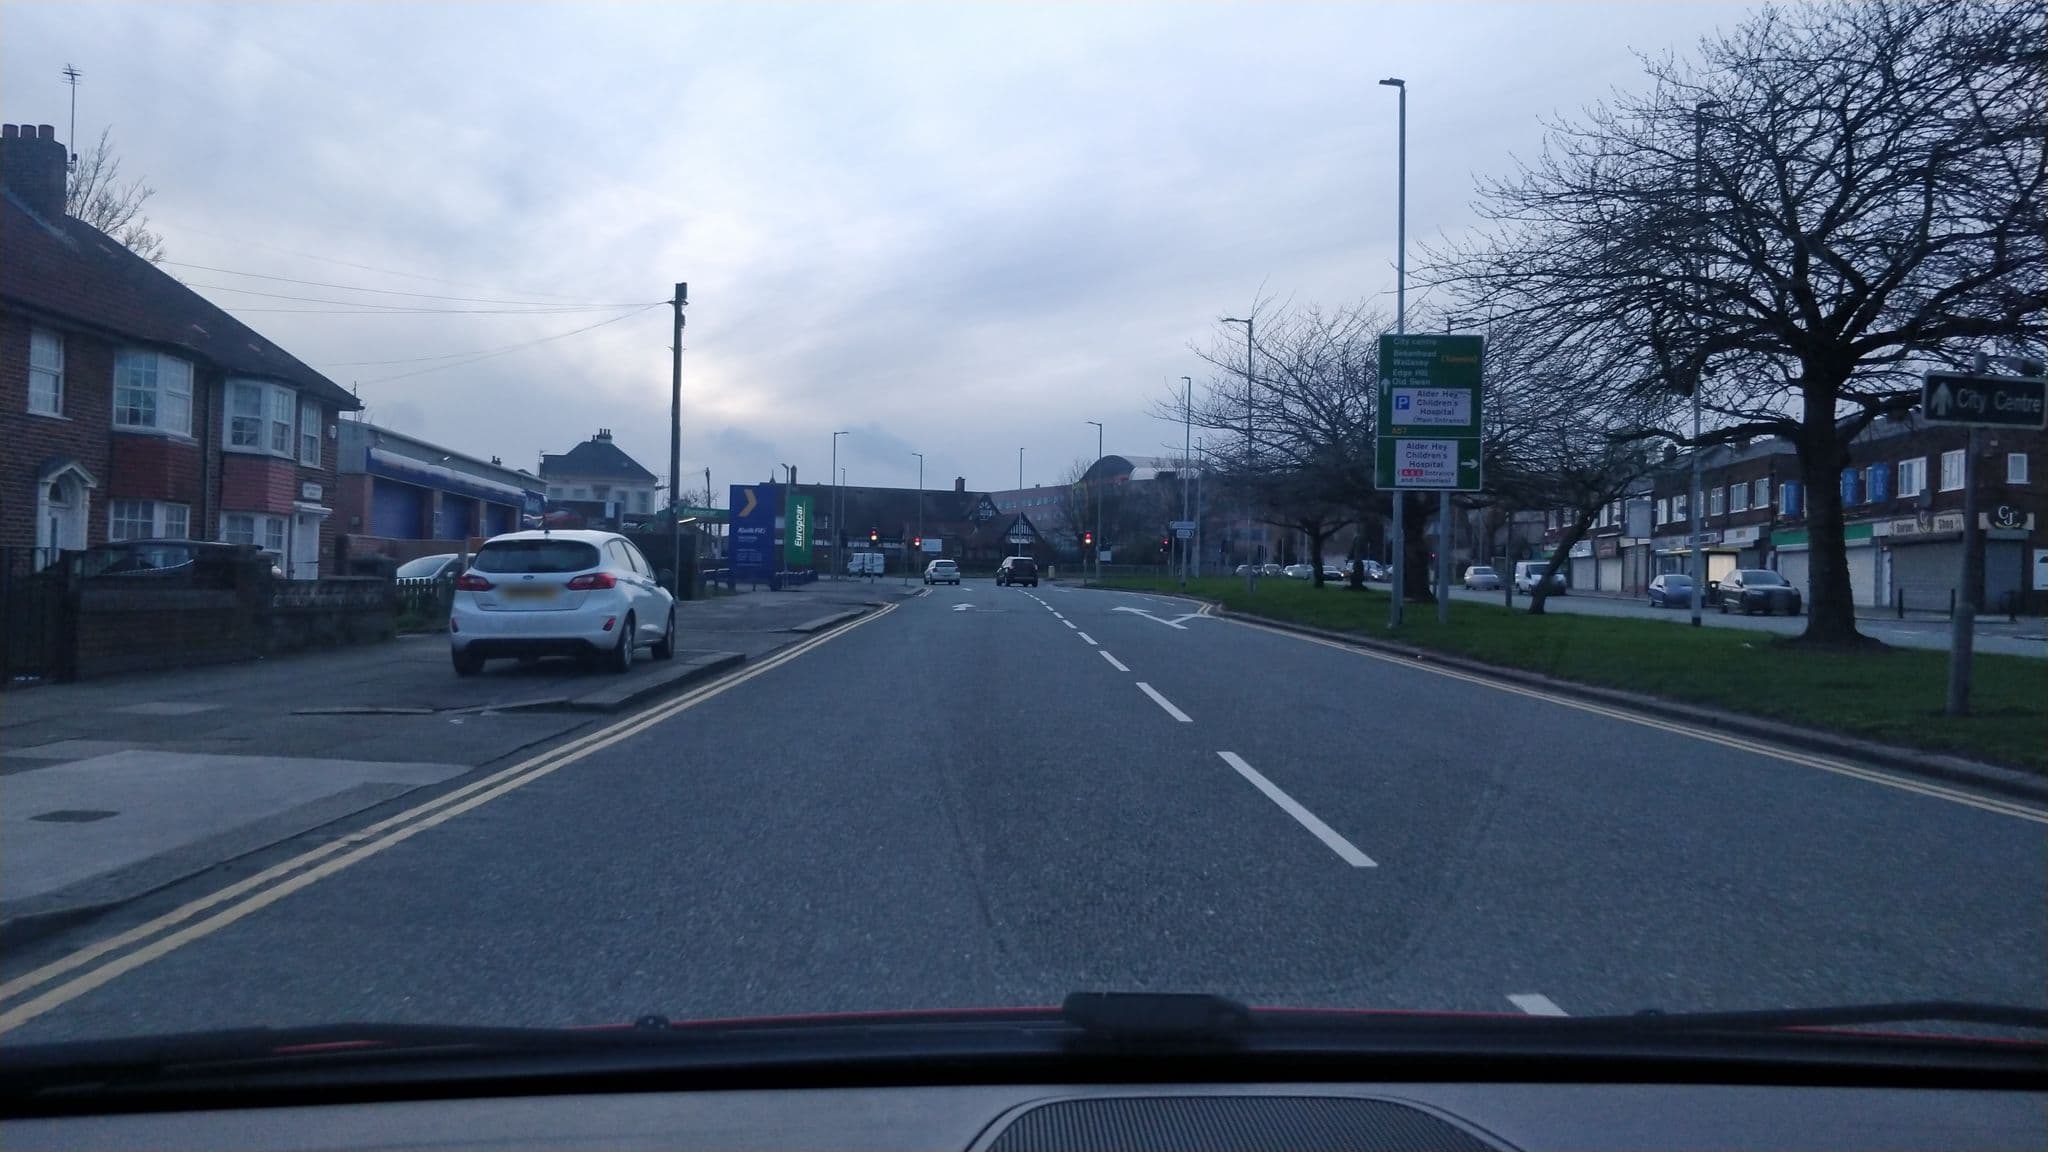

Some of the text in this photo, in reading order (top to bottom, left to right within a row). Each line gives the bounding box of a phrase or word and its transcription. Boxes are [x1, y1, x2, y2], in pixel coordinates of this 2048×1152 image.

[1392, 377, 1407, 385] Old
[1416, 390, 1458, 399] Alder Hey
[1416, 399, 1458, 407] Children's
[1957, 387, 2042, 414] City Centre
[1420, 408, 1455, 417] Hospital
[1406, 442, 1448, 451] Alder Hey
[1405, 451, 1448, 459] Children's
[1408, 460, 1444, 469] Hospital
[794, 504, 804, 547] Europcar
